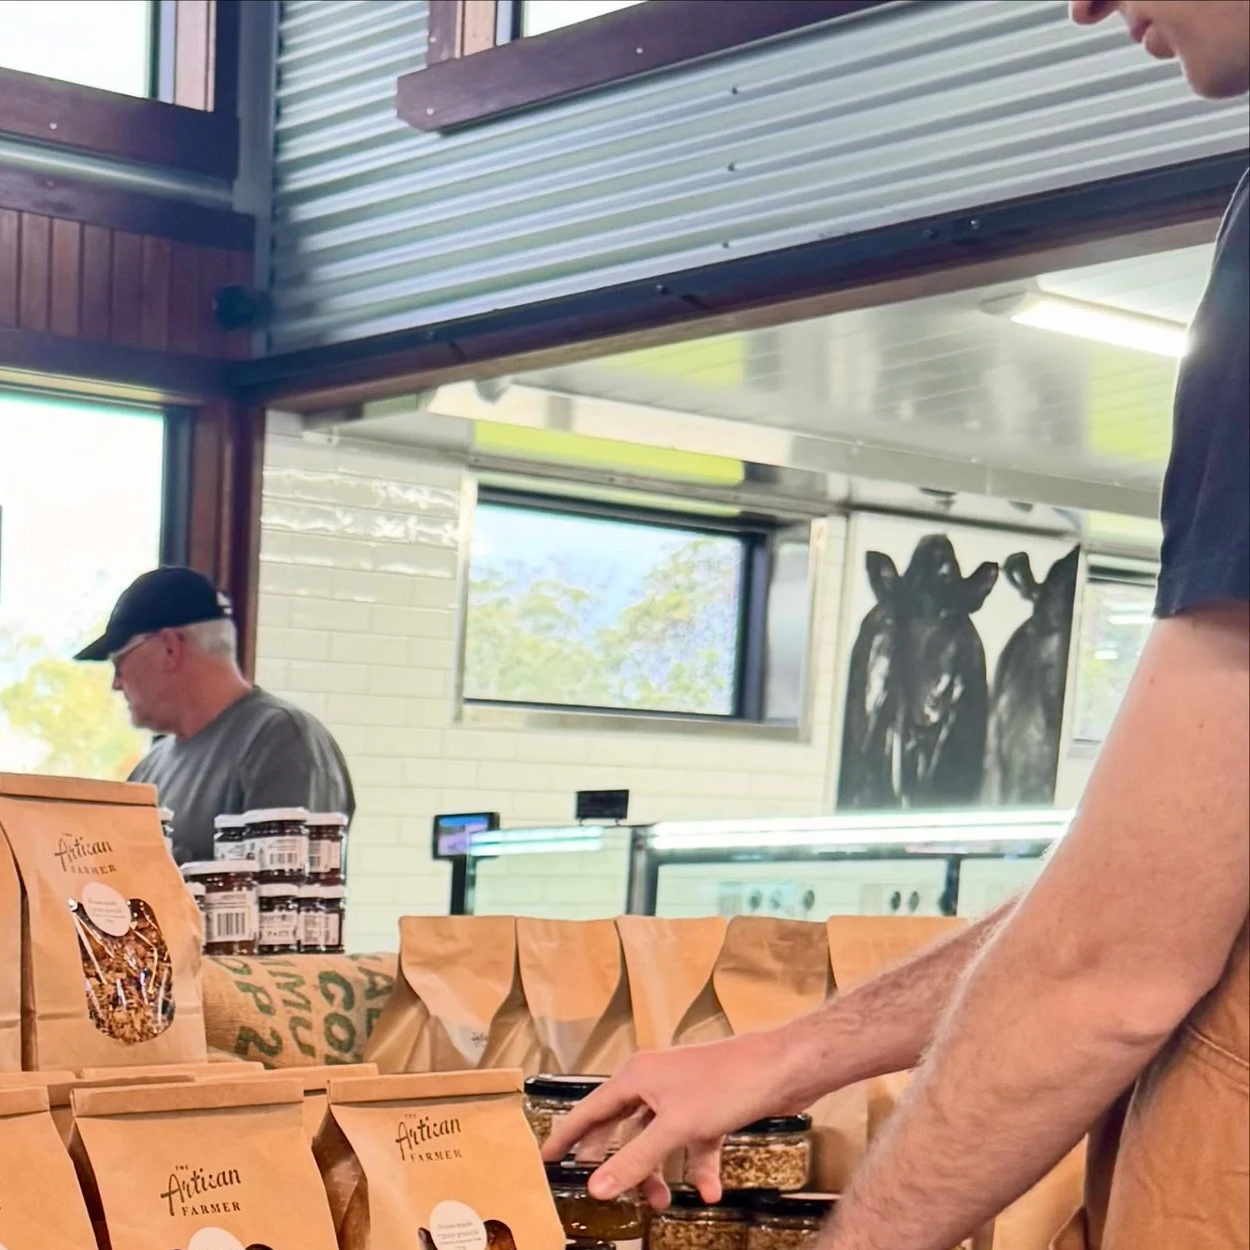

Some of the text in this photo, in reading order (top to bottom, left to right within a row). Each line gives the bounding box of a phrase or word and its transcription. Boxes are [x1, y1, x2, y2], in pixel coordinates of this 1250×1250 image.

[54, 837, 113, 872] Artisan
[395, 1116, 462, 1161] Artisan
[411, 1149, 463, 1162] FARMER
[160, 1167, 241, 1216] Artisan
[181, 1201, 241, 1217] FARMER
